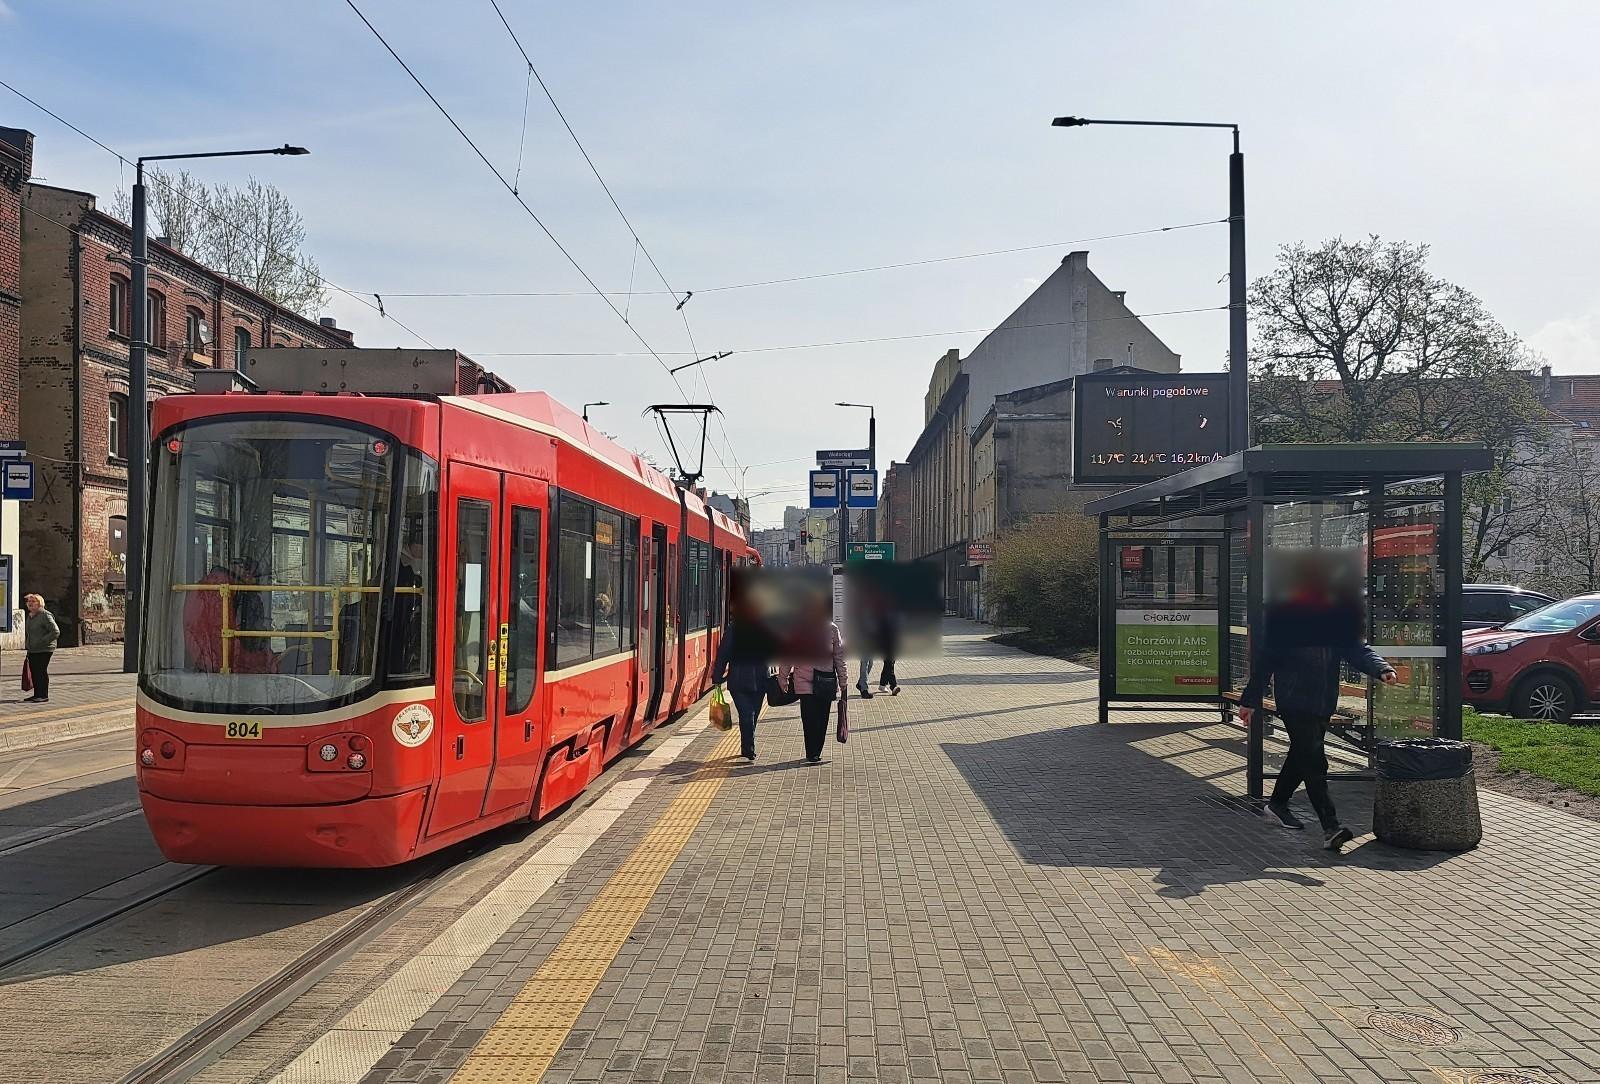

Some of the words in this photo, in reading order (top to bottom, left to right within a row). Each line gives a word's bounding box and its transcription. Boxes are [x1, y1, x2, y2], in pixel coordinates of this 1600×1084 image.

[1105, 387, 1149, 397] Warunki
[1152, 386, 1209, 399] pogodowe
[1131, 453, 1167, 464] 21,4°C
[1143, 613, 1191, 622] CHORZÓW
[1127, 636, 1175, 645] Chorzów
[1183, 637, 1207, 645] AMS
[1124, 648, 1192, 658] rozbudowujemy
[1174, 658, 1208, 666] mieście
[227, 722, 260, 738] 804
